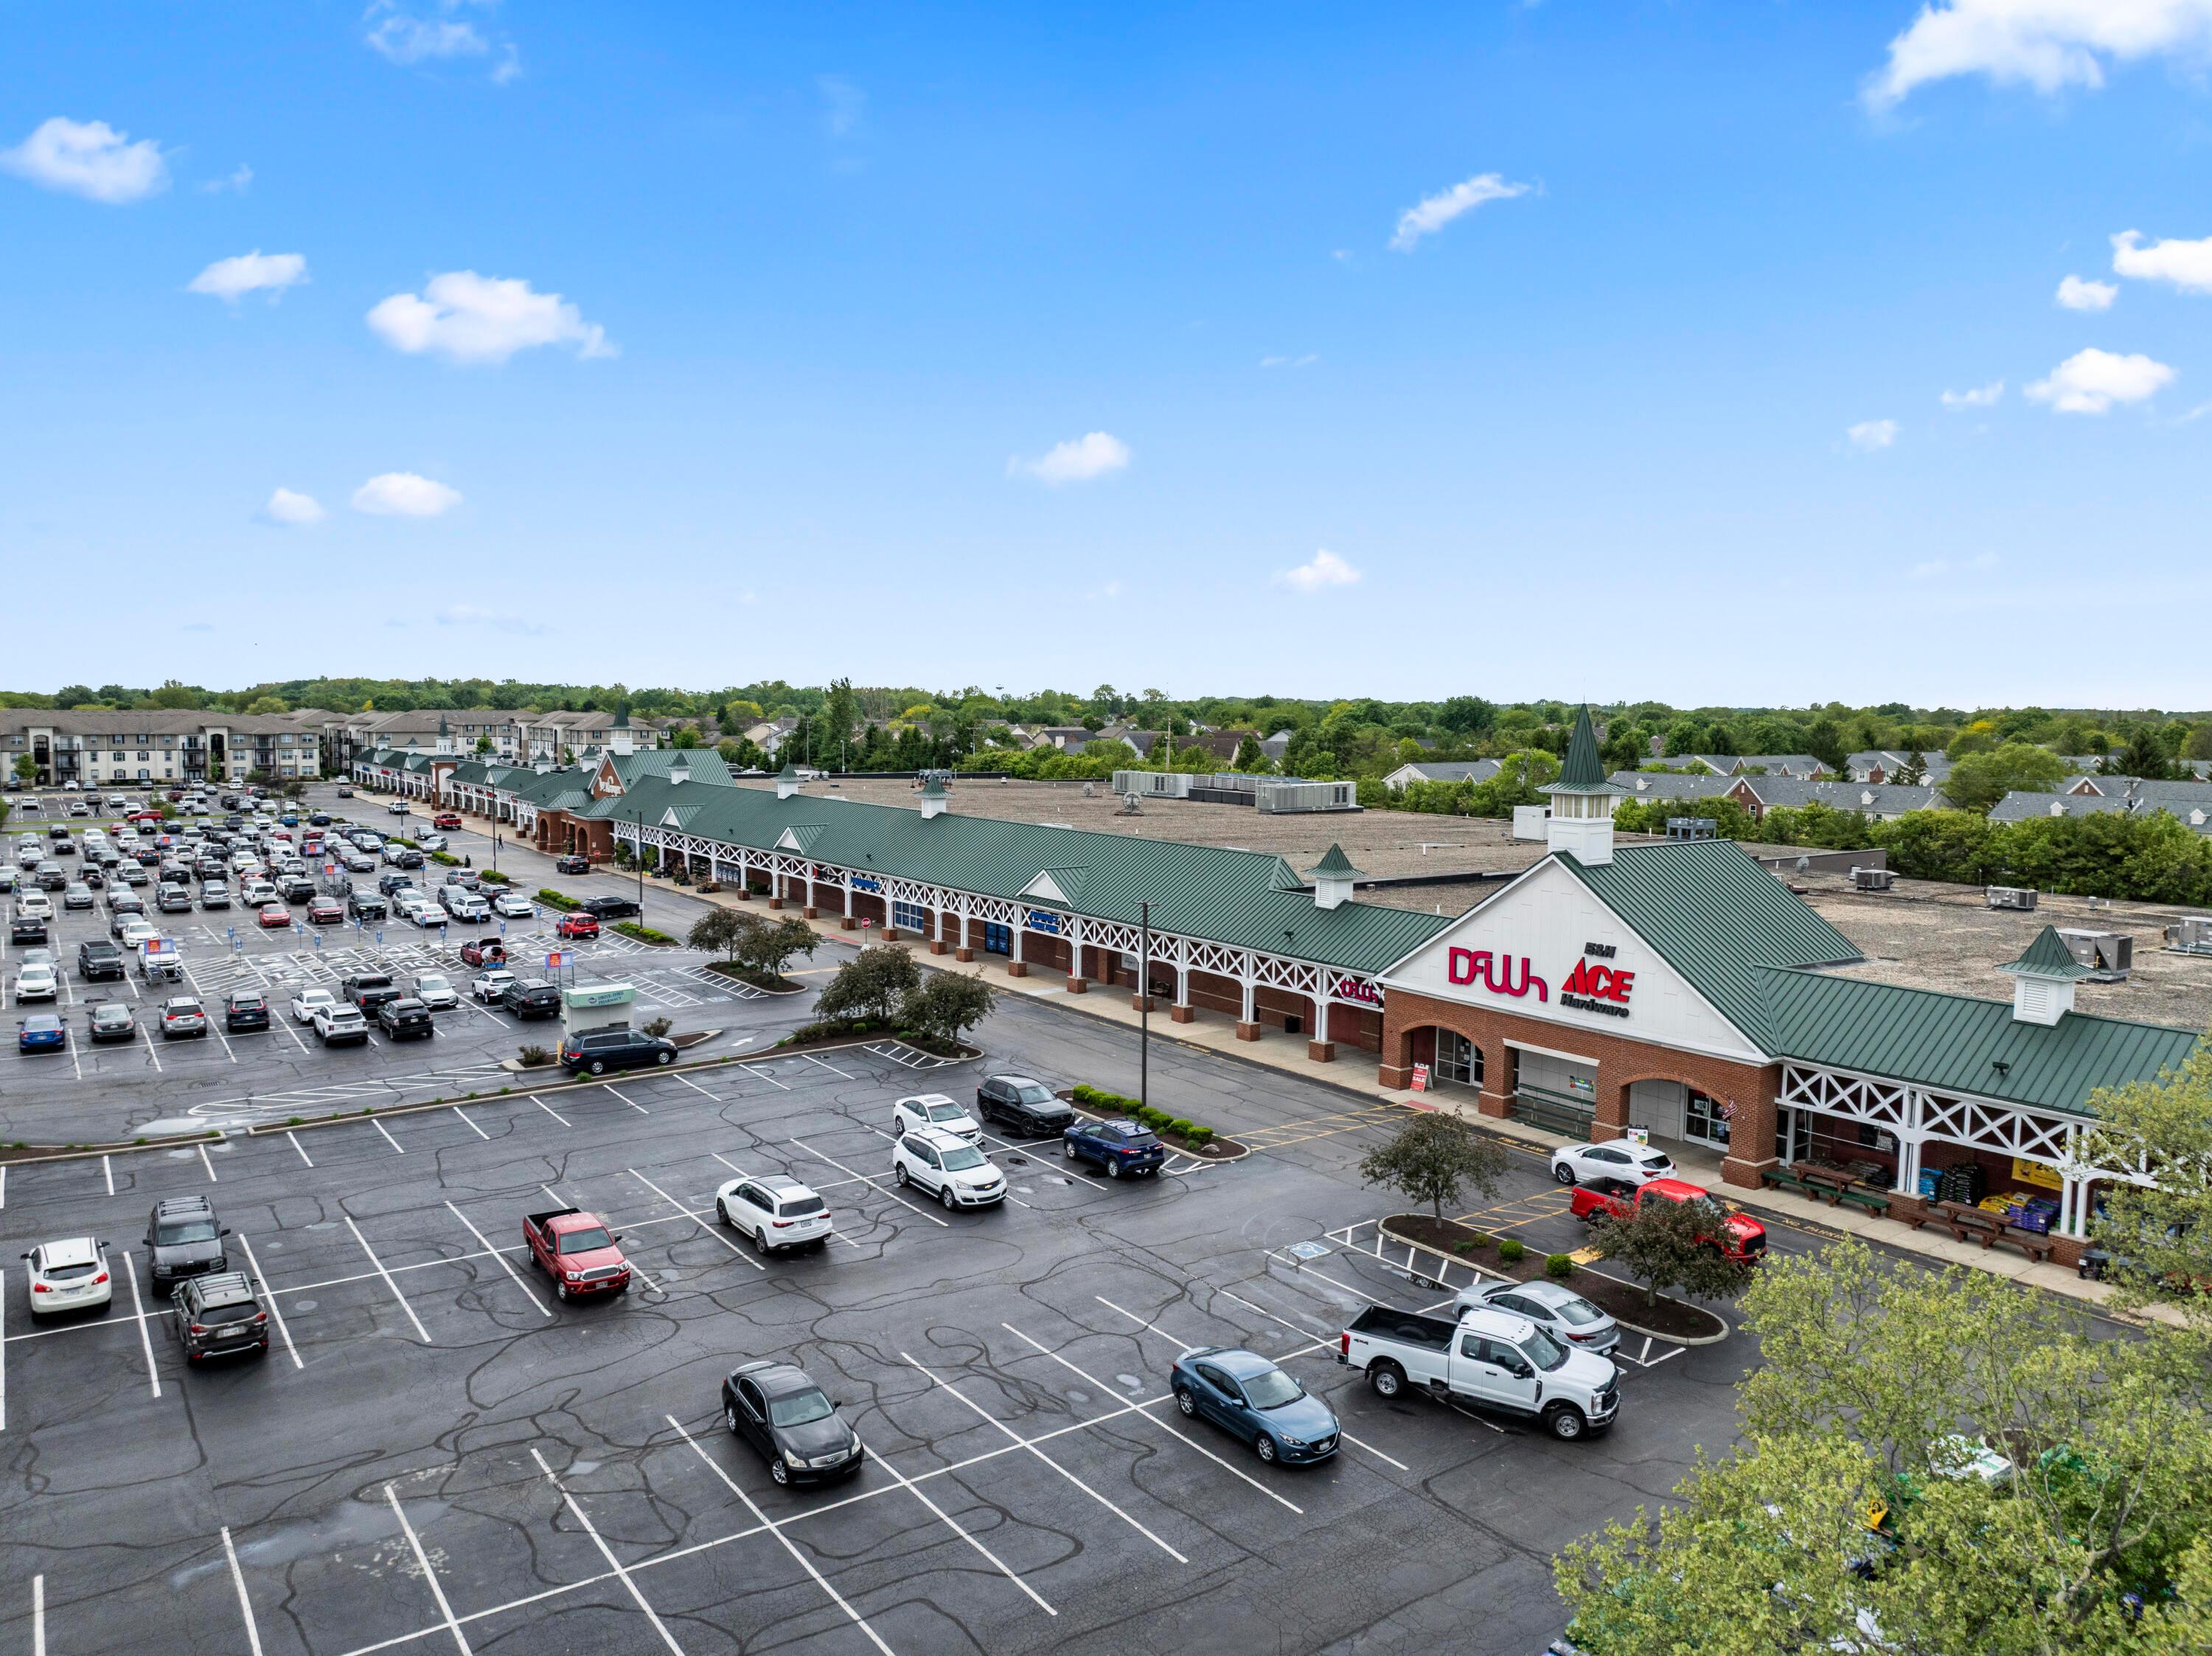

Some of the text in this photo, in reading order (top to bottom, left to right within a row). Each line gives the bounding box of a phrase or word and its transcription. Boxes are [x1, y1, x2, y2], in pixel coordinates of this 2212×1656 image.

[1584, 942, 1616, 959] E&H
[1561, 957, 1635, 1003] ACE
[1559, 993, 1630, 1017] Hardware
[1498, 1136, 1522, 1144] FIRE
[1804, 1225, 1848, 1239] PARKIN
